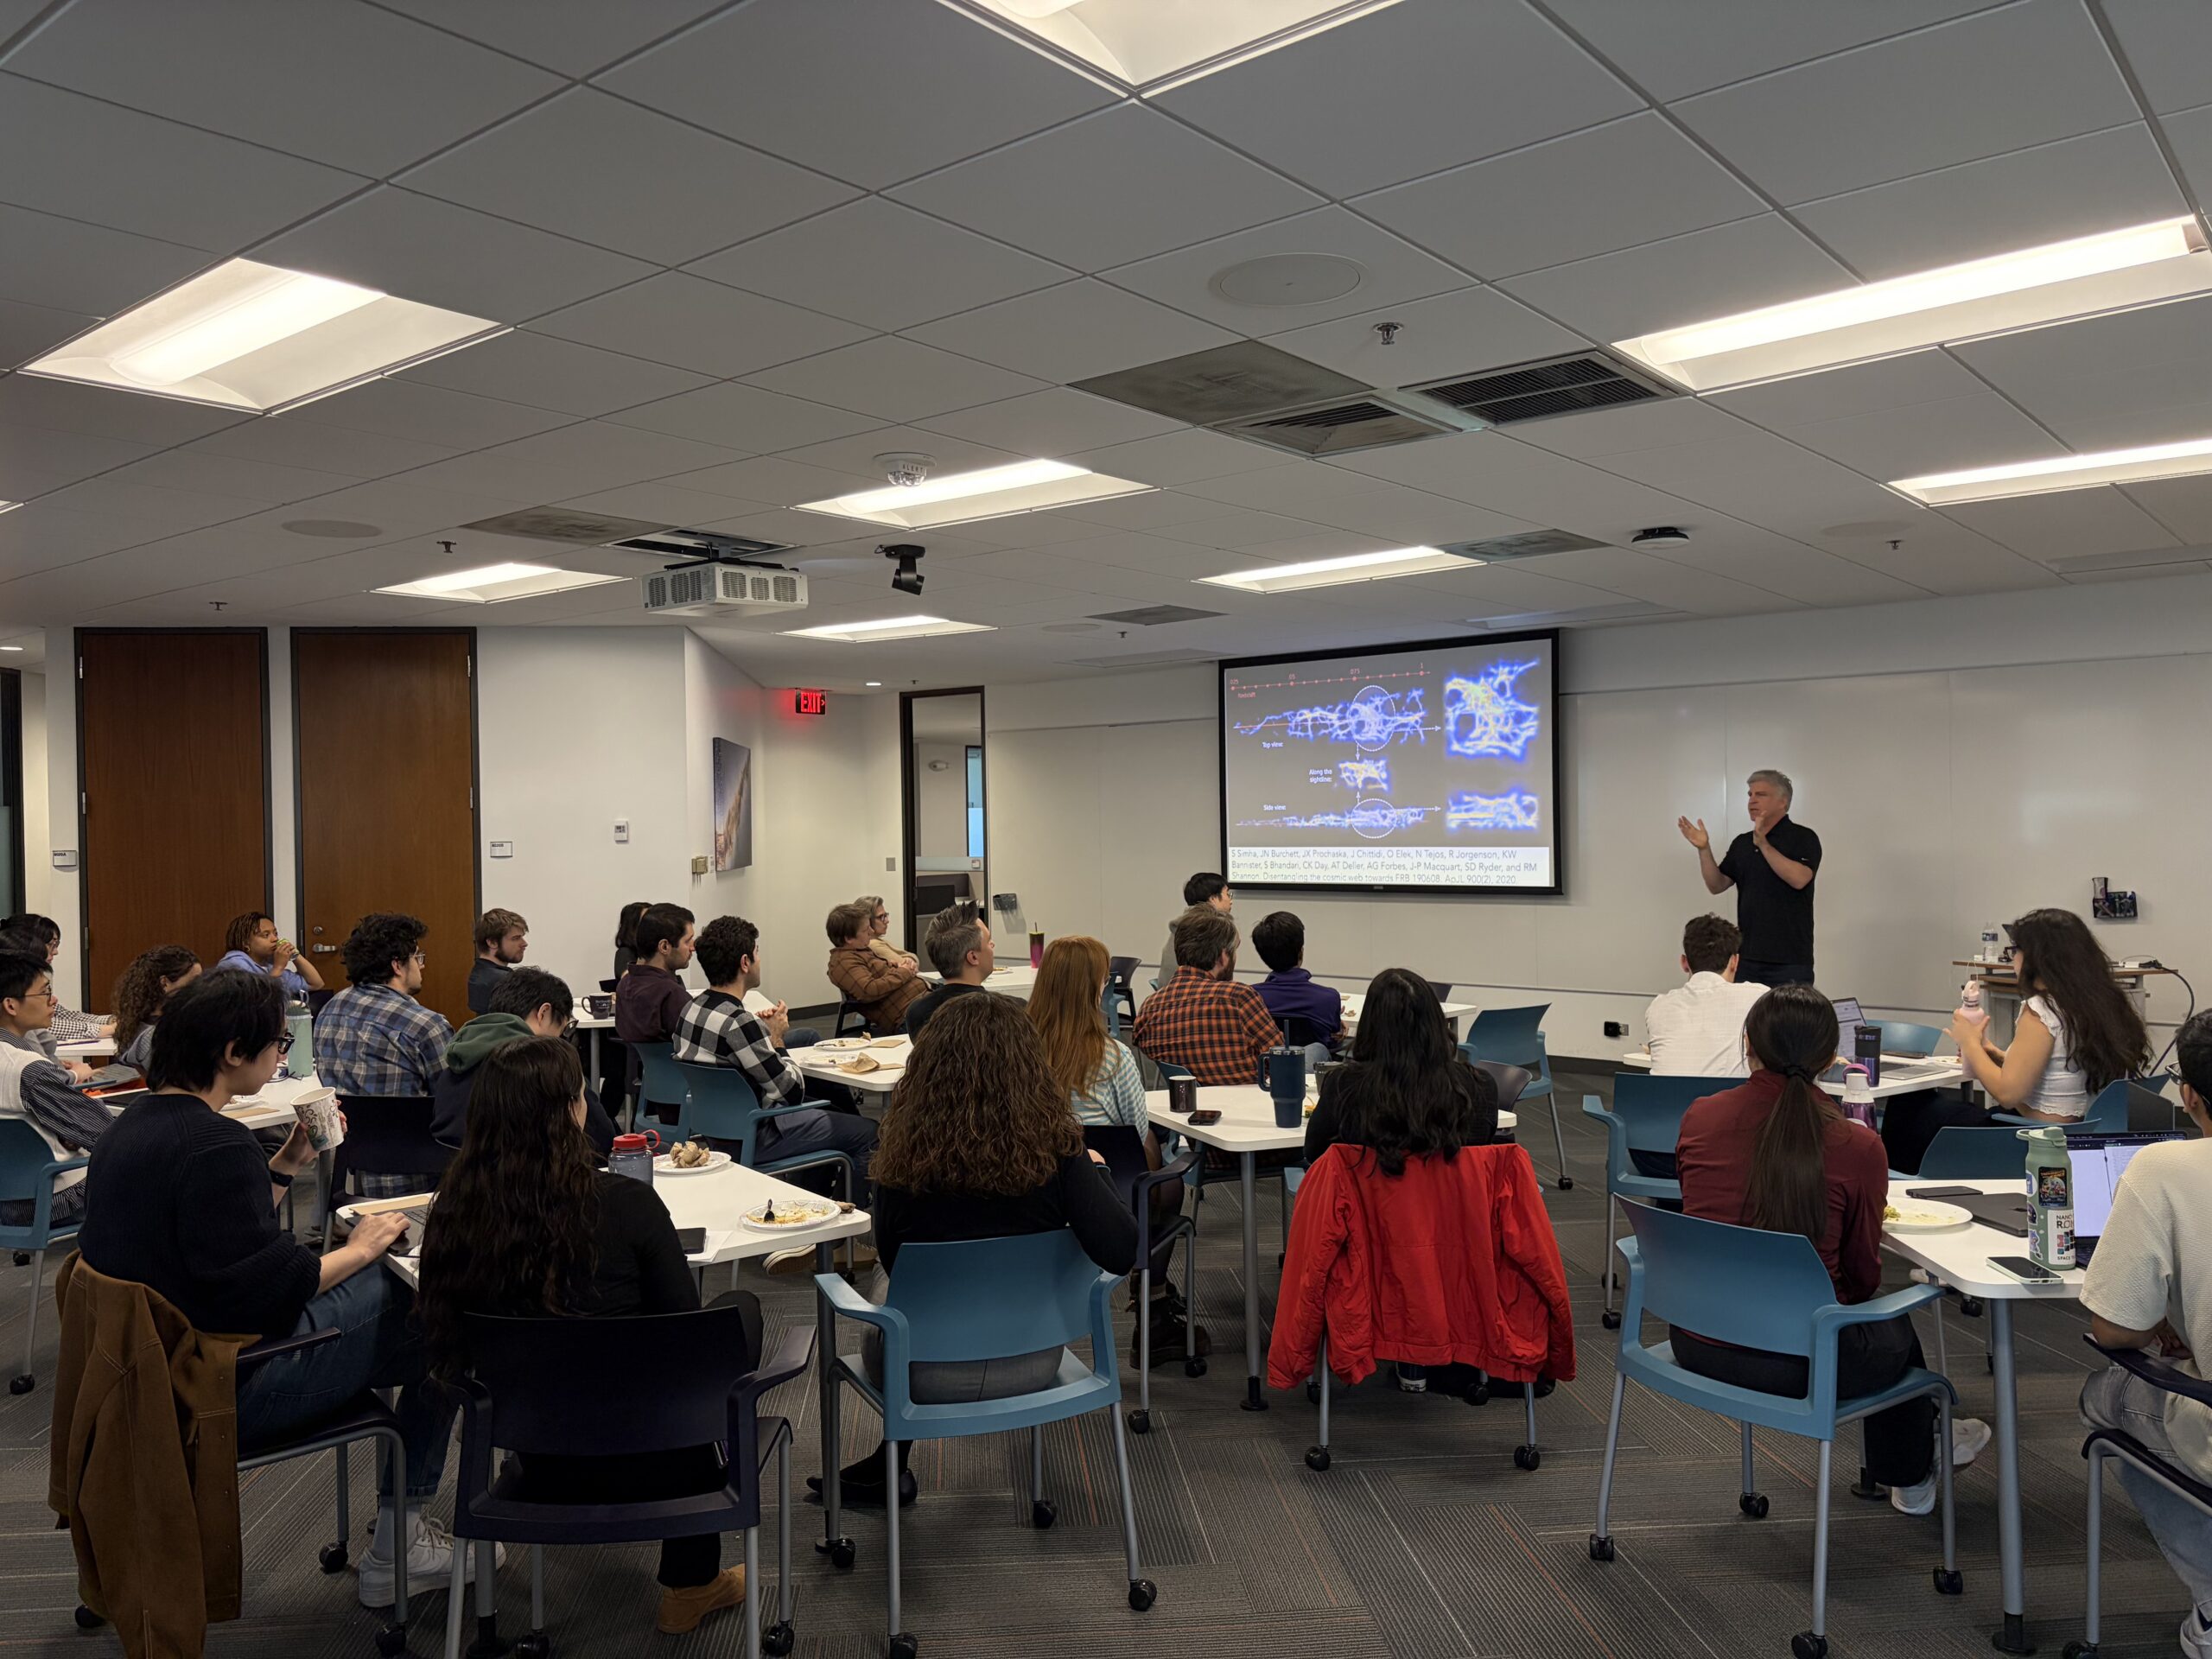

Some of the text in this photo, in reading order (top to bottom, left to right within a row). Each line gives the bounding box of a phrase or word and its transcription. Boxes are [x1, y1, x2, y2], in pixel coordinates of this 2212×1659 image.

[902, 464, 924, 473] ALERT
[801, 692, 822, 713] EXIT
[1237, 849, 1258, 858] Simha,
[1261, 849, 1269, 858] JN
[1271, 849, 1300, 858] Burchett,
[1302, 849, 1311, 858] JX
[1313, 849, 1349, 859] Prochaska,
[1387, 849, 1394, 858] O
[1396, 849, 1413, 859] Elek,
[1415, 849, 1422, 858] N
[1424, 849, 1446, 861] Tejos,
[1448, 849, 1454, 858] R
[1456, 850, 1500, 861] Jorgenson,
[1502, 850, 1517, 859] KW
[1231, 861, 1262, 870] Bannister,
[1302, 861, 1313, 869] CK
[1332, 861, 1340, 870] AT
[1367, 861, 1378, 870] AG
[1381, 861, 1408, 871] Forbes,
[1409, 861, 1421, 871] J-P
[1424, 861, 1463, 873] Macquart,
[1465, 862, 1477, 871] SD
[1478, 862, 1503, 874] Ryder,
[1506, 862, 1521, 872] and
[1523, 862, 1537, 872] RM
[1348, 873, 1363, 881] web
[1395, 874, 1410, 882] FRB
